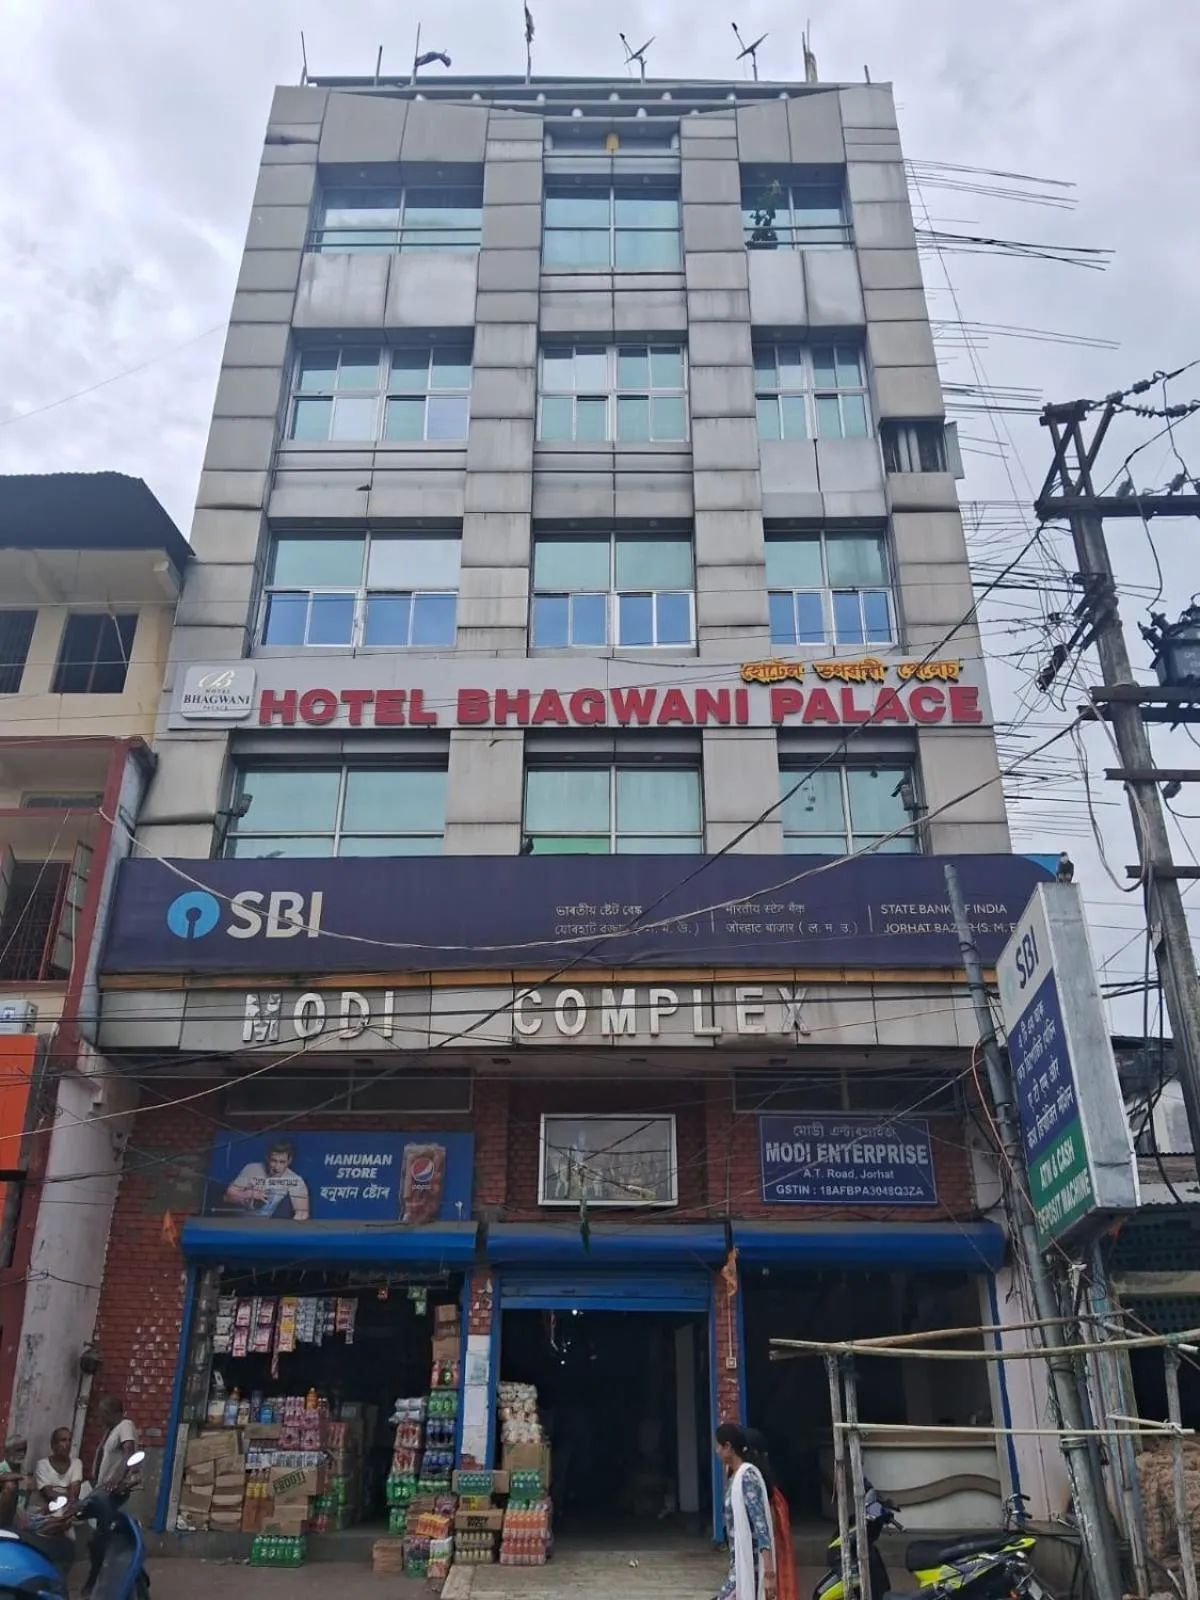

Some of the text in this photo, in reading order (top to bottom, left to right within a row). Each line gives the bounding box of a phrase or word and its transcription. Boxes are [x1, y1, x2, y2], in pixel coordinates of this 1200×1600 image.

[740, 657, 804, 684] হোটেল
[183, 694, 250, 705] BHAGWANI
[258, 686, 982, 726] HOTEL BHAGWANI PALACE
[226, 891, 323, 938] SBI
[880, 903, 918, 915] STATE
[919, 903, 952, 915] BANK
[973, 903, 1007, 915] INDIA
[884, 922, 931, 934] JORHAT
[1016, 925, 1039, 989] SBI
[242, 986, 811, 1041] MODI COMPLEX
[324, 1153, 393, 1166] HANUMAN
[765, 1141, 929, 1164] MODI ENTERPRISE
[1039, 1159, 1053, 1191] ATM
[1057, 1136, 1075, 1174] CASH
[336, 1167, 378, 1179] STORE
[803, 1168, 894, 1180] A.T. Road, Jorhat
[776, 1184, 810, 1195] GSTIN
[820, 1185, 924, 1197] 18AFBPA3048Q3ZA
[1037, 1168, 1091, 1235] DEPOSIT MACHINE
